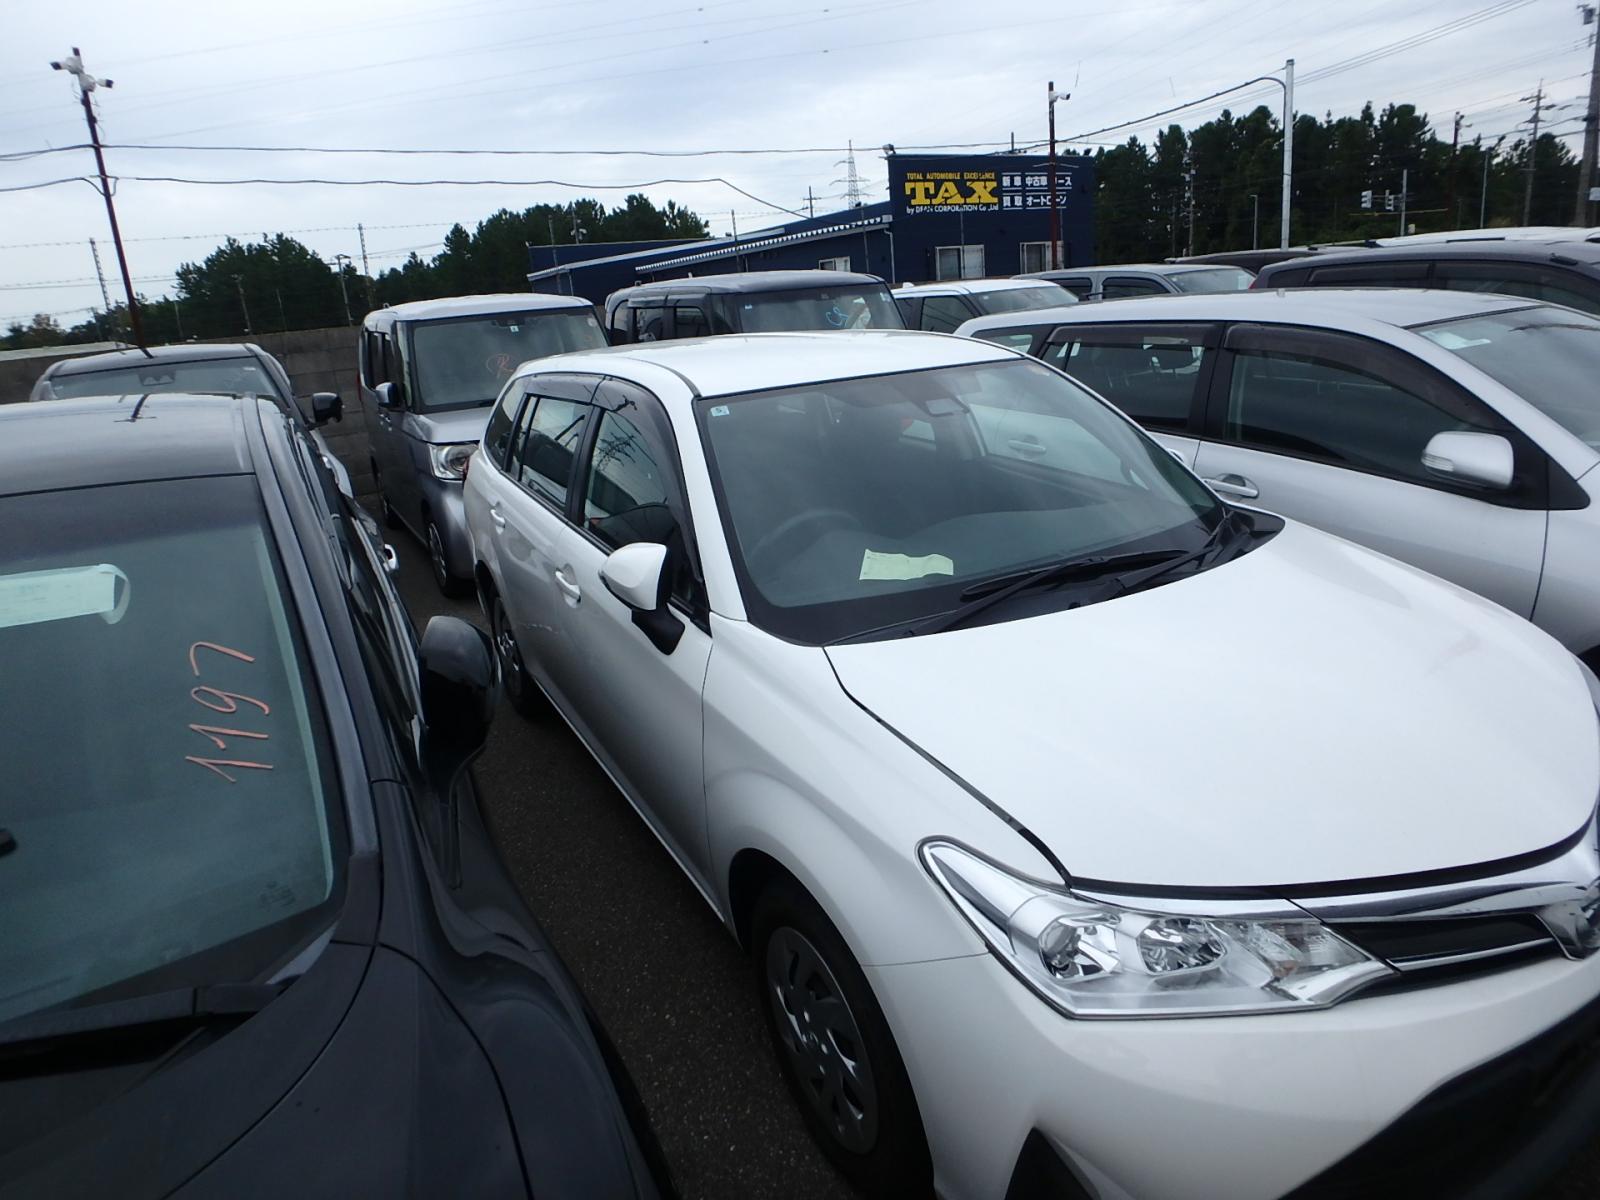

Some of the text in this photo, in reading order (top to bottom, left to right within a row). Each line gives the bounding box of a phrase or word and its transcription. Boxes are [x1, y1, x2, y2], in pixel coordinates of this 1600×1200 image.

[907, 172, 923, 180] TOTAL
[926, 172, 960, 180] AUTOMOBILE
[905, 181, 999, 205] TAX
[185, 641, 274, 783] 1197
